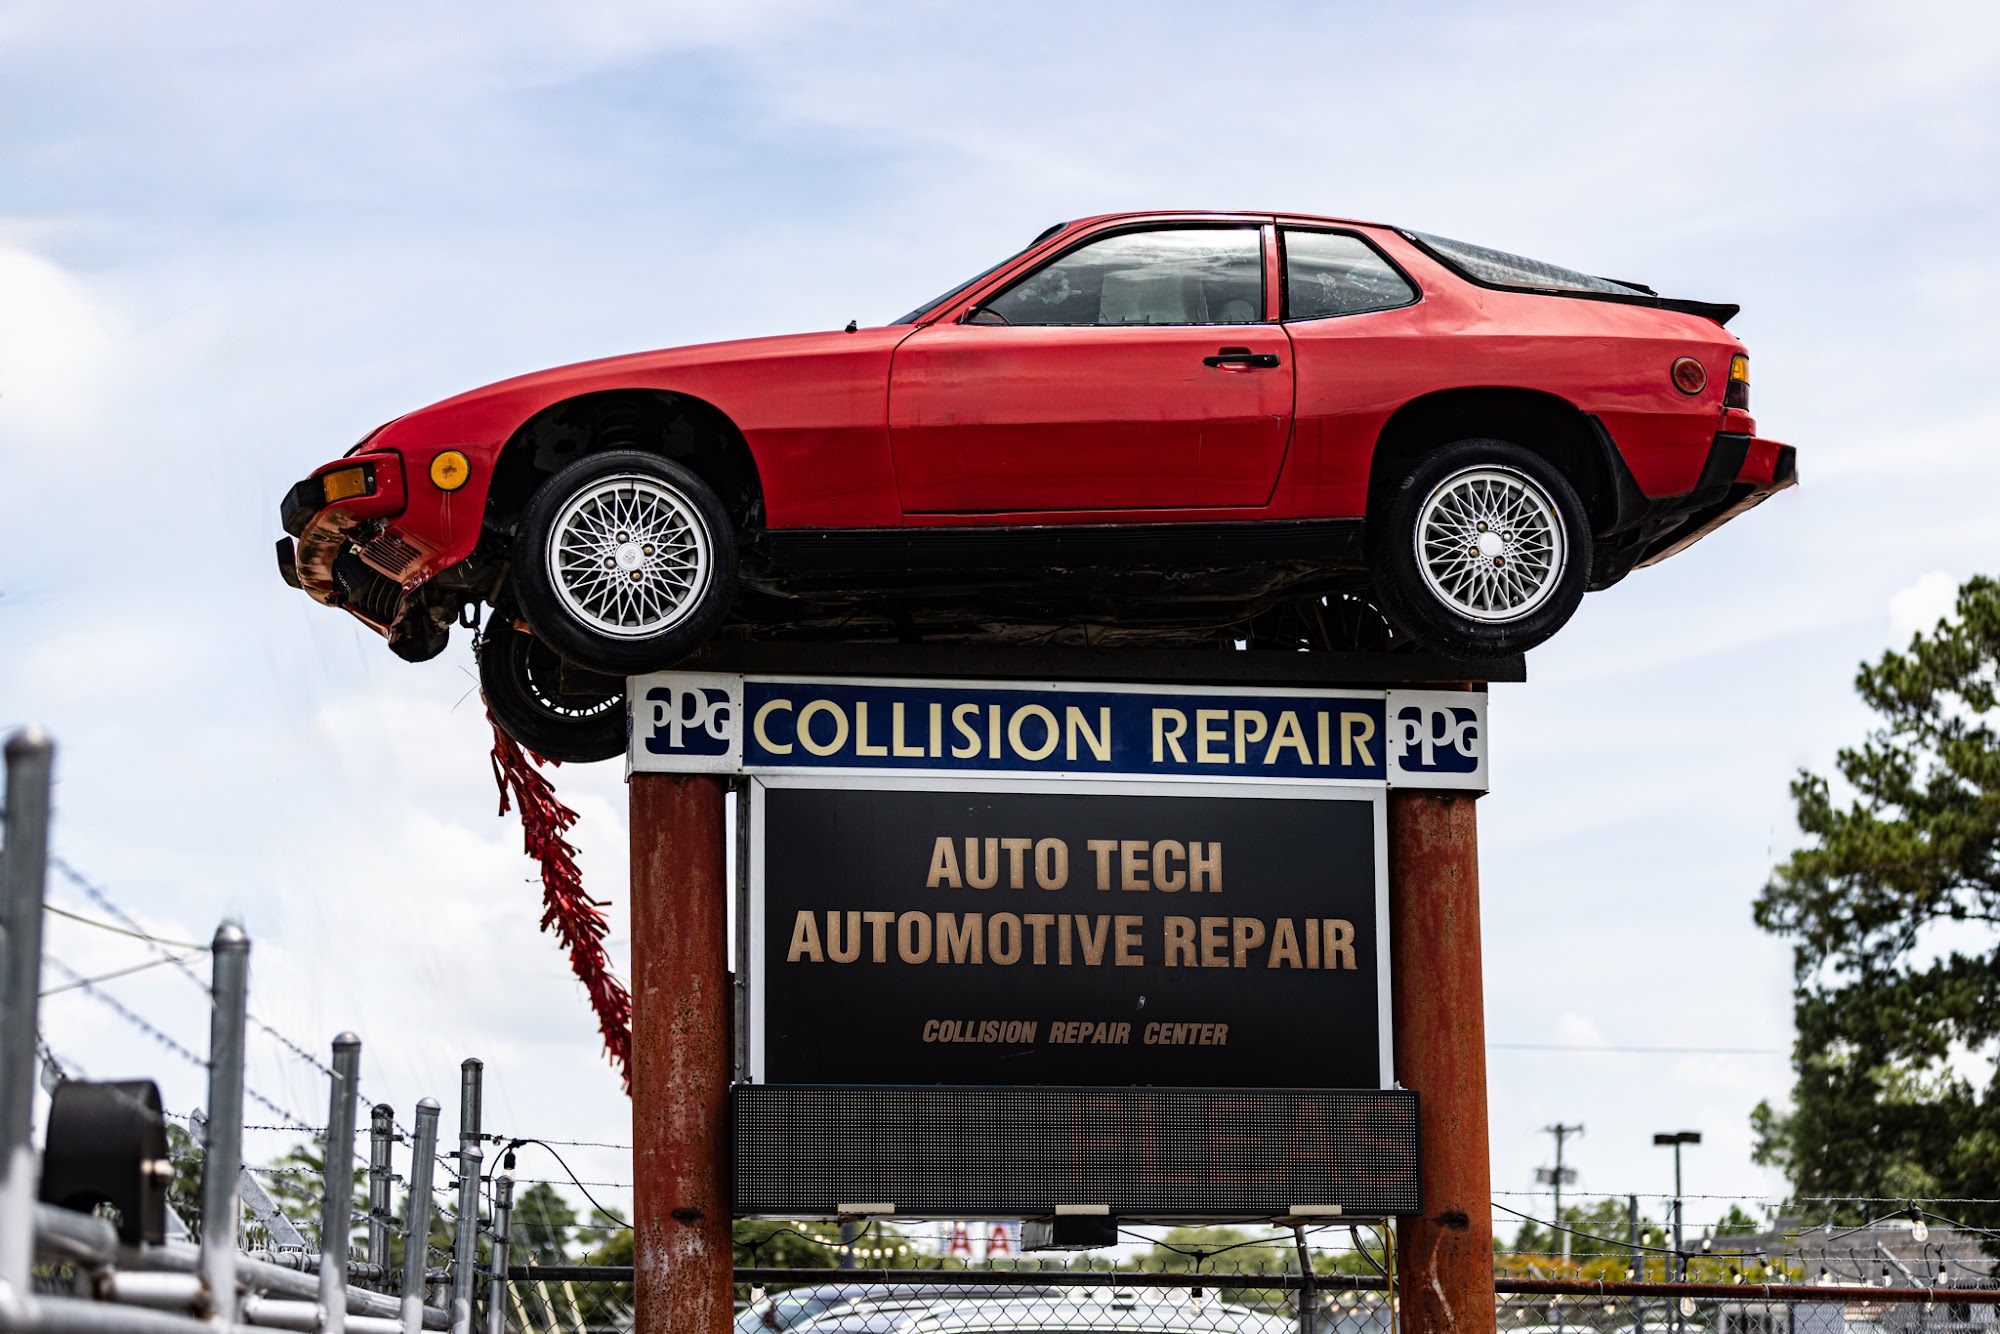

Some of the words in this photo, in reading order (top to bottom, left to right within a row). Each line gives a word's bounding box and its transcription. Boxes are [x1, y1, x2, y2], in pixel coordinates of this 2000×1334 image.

[753, 699, 1112, 761] COLLISION
[1152, 708, 1376, 766] REPAIR
[926, 836, 1069, 891] AUTO
[1087, 838, 1223, 893] TECH
[786, 909, 1144, 967] AUTOMOTIVE
[1163, 915, 1358, 970] REPAIR
[922, 1018, 1038, 1044] COLLISION
[1048, 1021, 1132, 1045] REPAIR
[1143, 1021, 1230, 1046] CENTER
